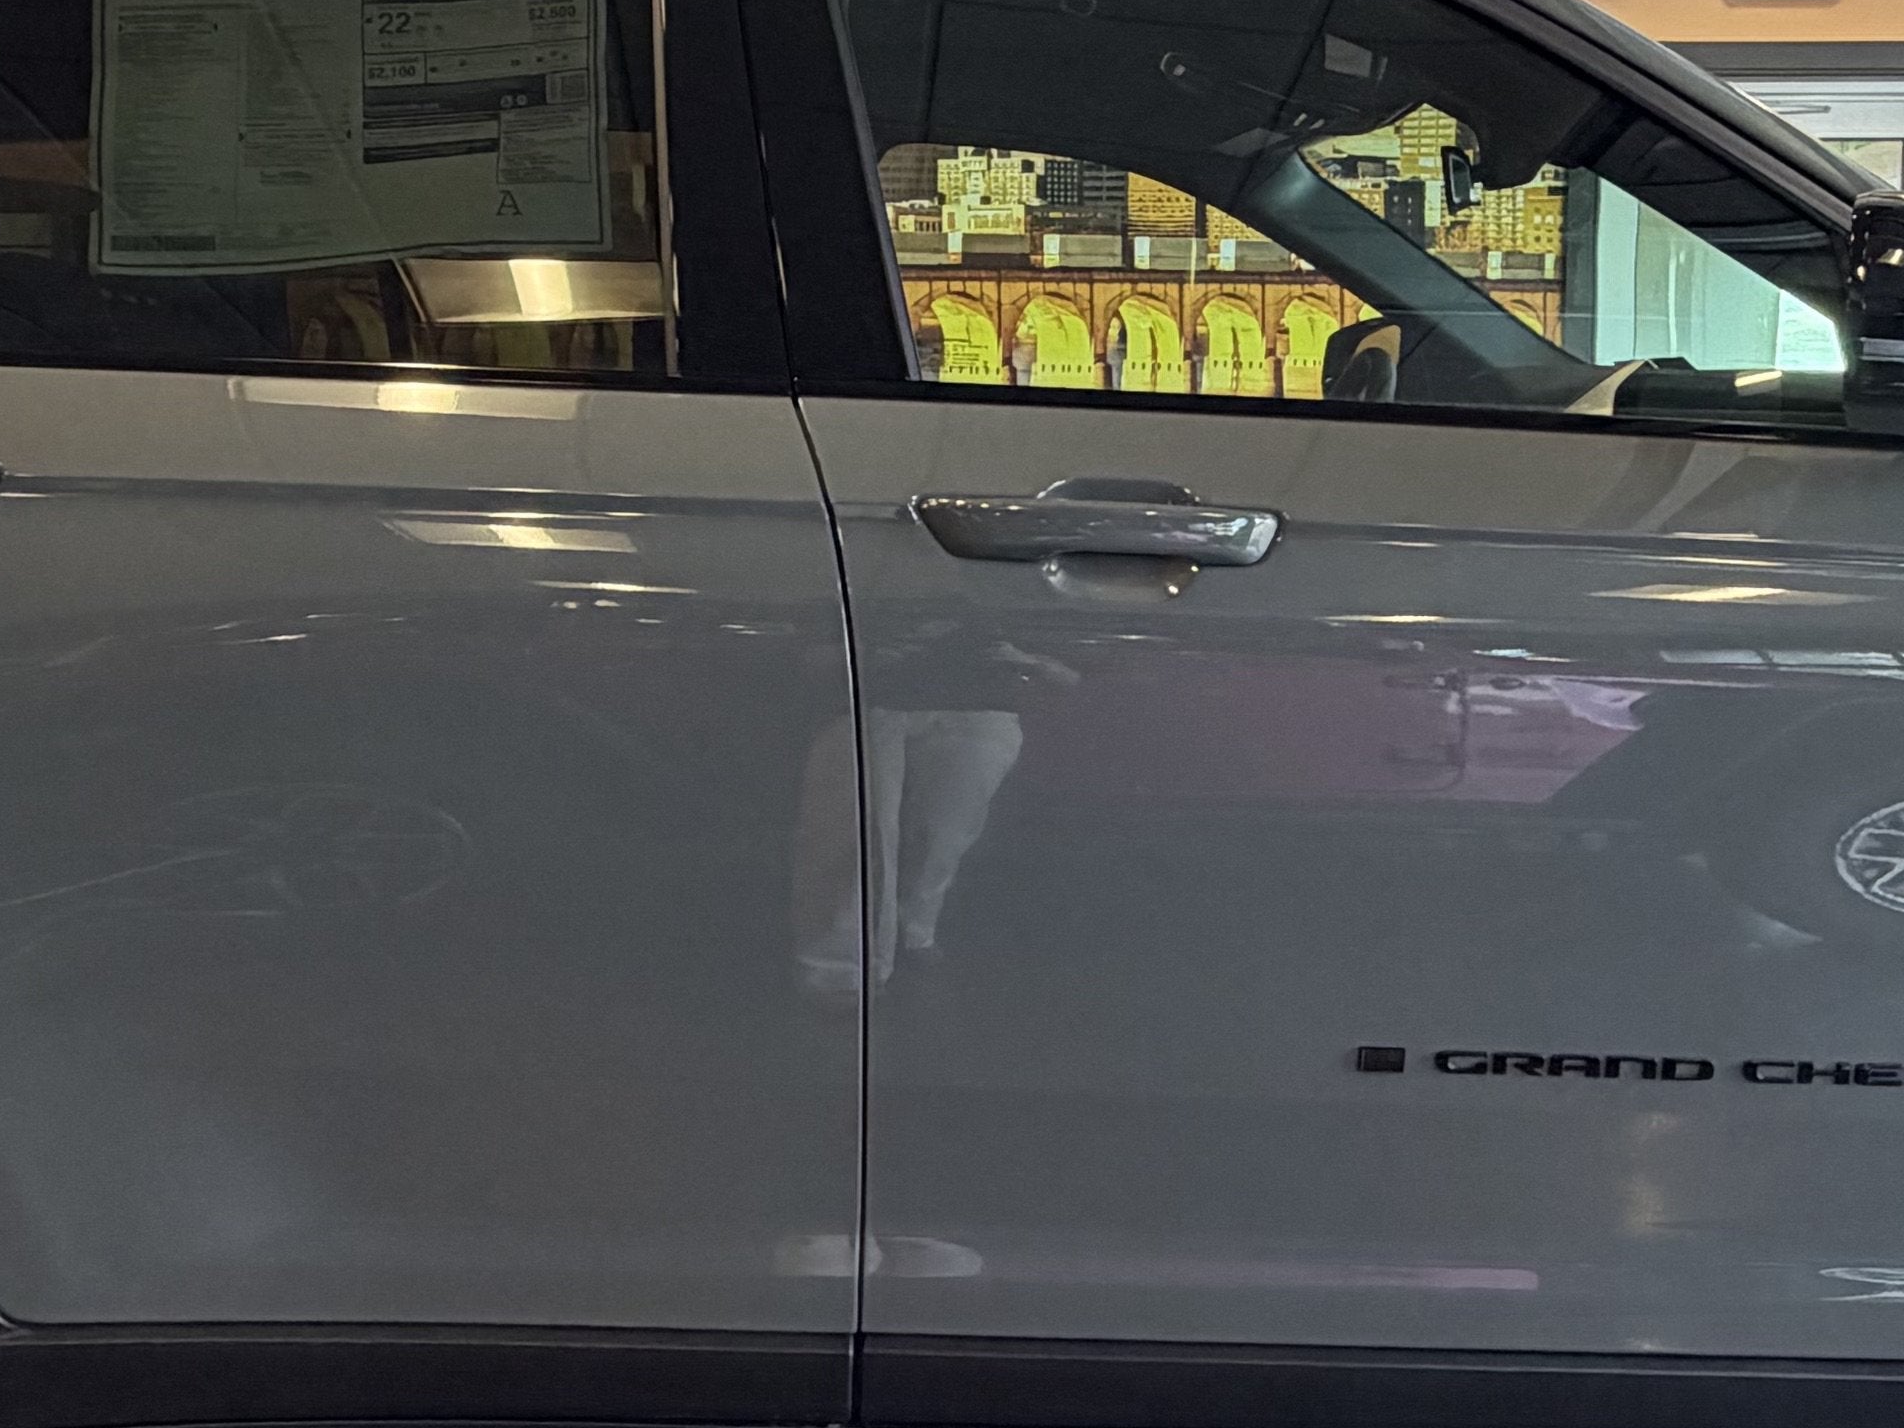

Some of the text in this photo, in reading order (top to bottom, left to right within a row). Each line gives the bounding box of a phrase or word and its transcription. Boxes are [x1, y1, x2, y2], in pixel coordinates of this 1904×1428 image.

[378, 12, 412, 35] 22
[496, 189, 523, 216] A
[1433, 1050, 1715, 1081] GRAND
